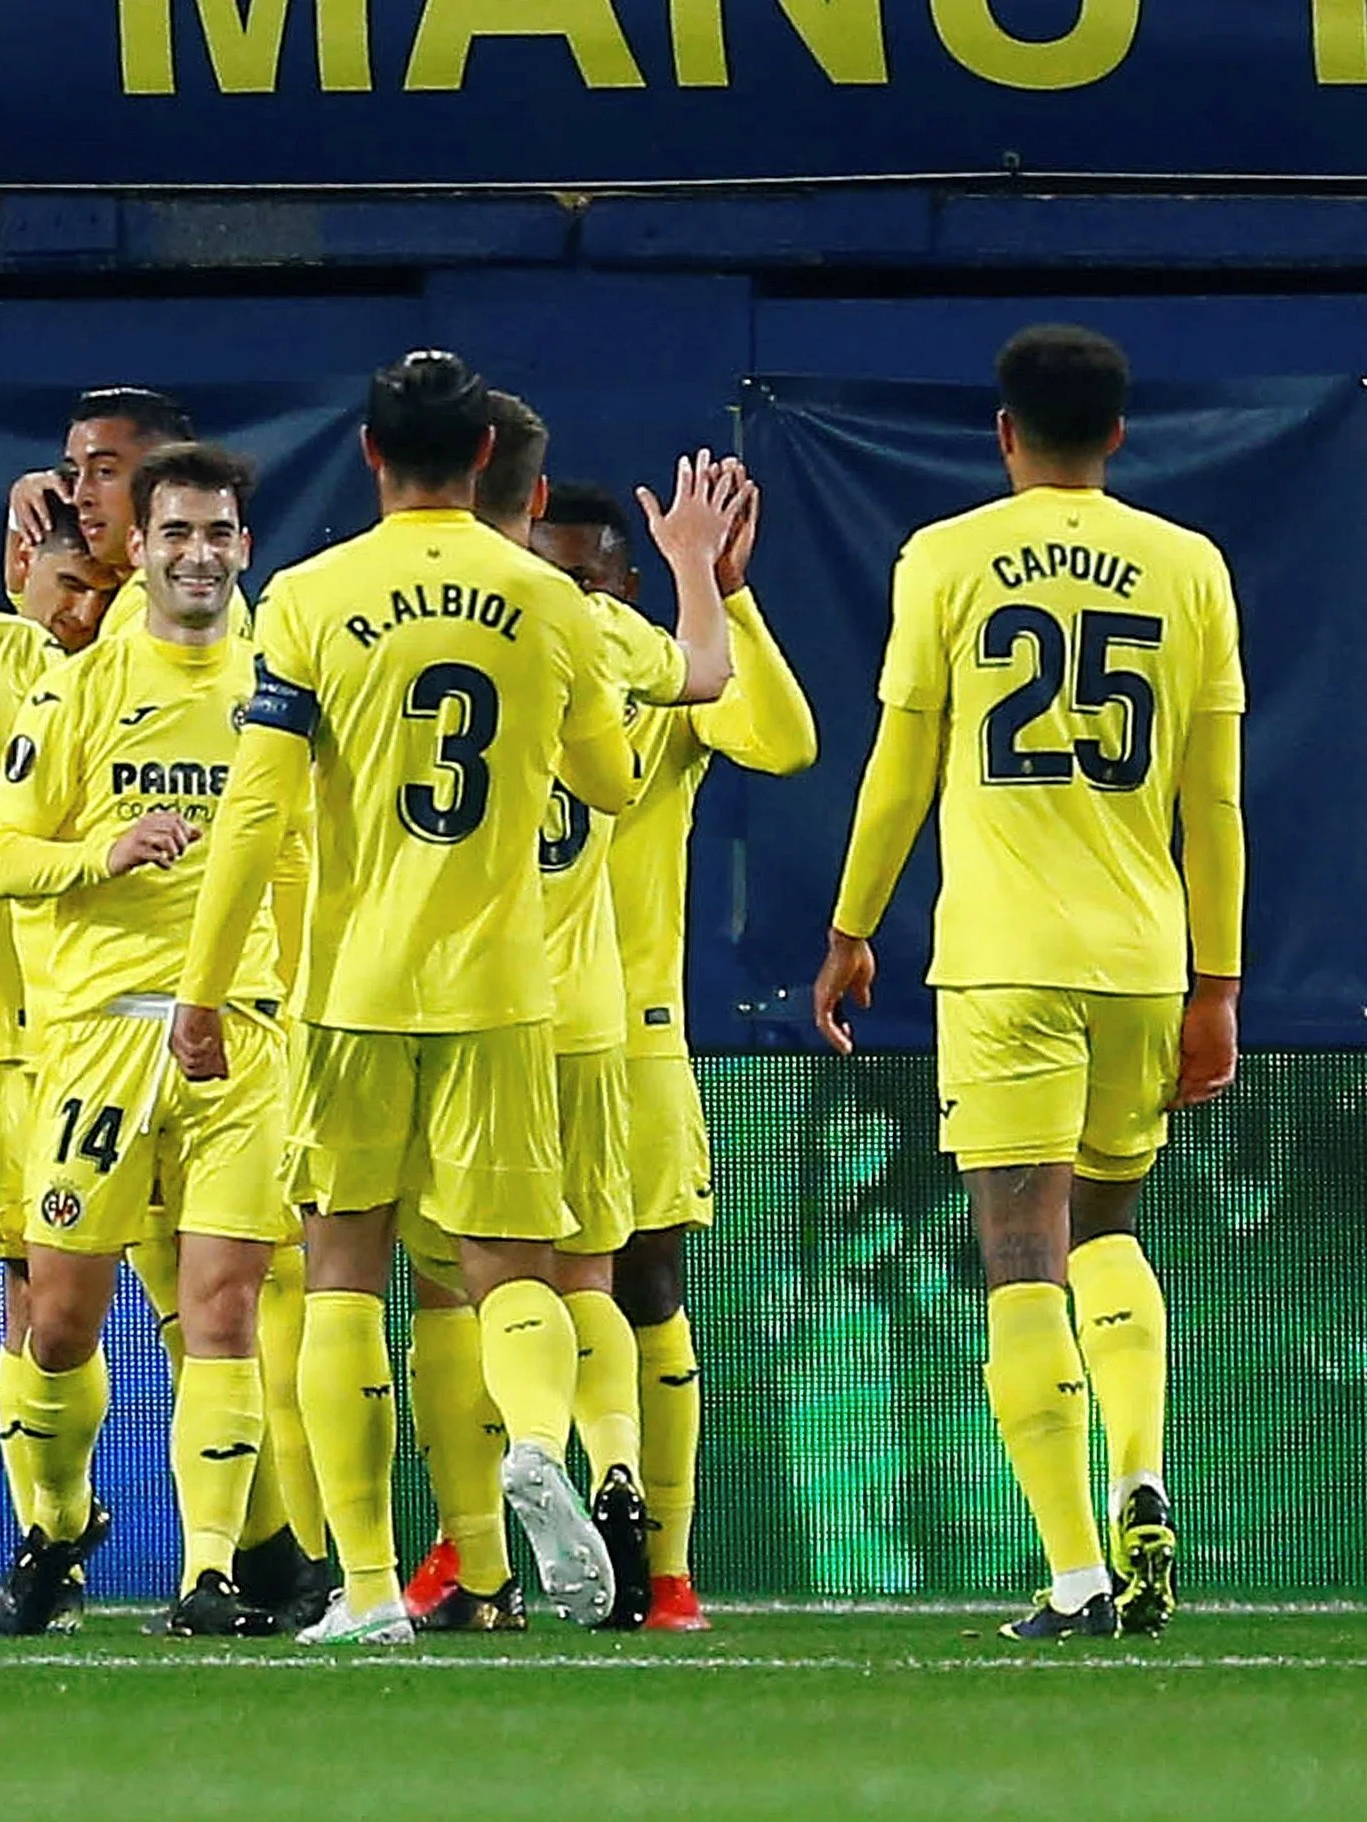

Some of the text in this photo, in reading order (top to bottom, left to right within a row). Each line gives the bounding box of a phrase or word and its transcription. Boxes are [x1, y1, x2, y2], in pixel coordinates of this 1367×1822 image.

[991, 544, 1141, 598] CAPOUE
[346, 584, 523, 647] R.ALBIOL
[974, 603, 1164, 793] 25
[112, 762, 231, 796] PAME
[396, 661, 500, 846] 3
[55, 1098, 124, 1174] 14
